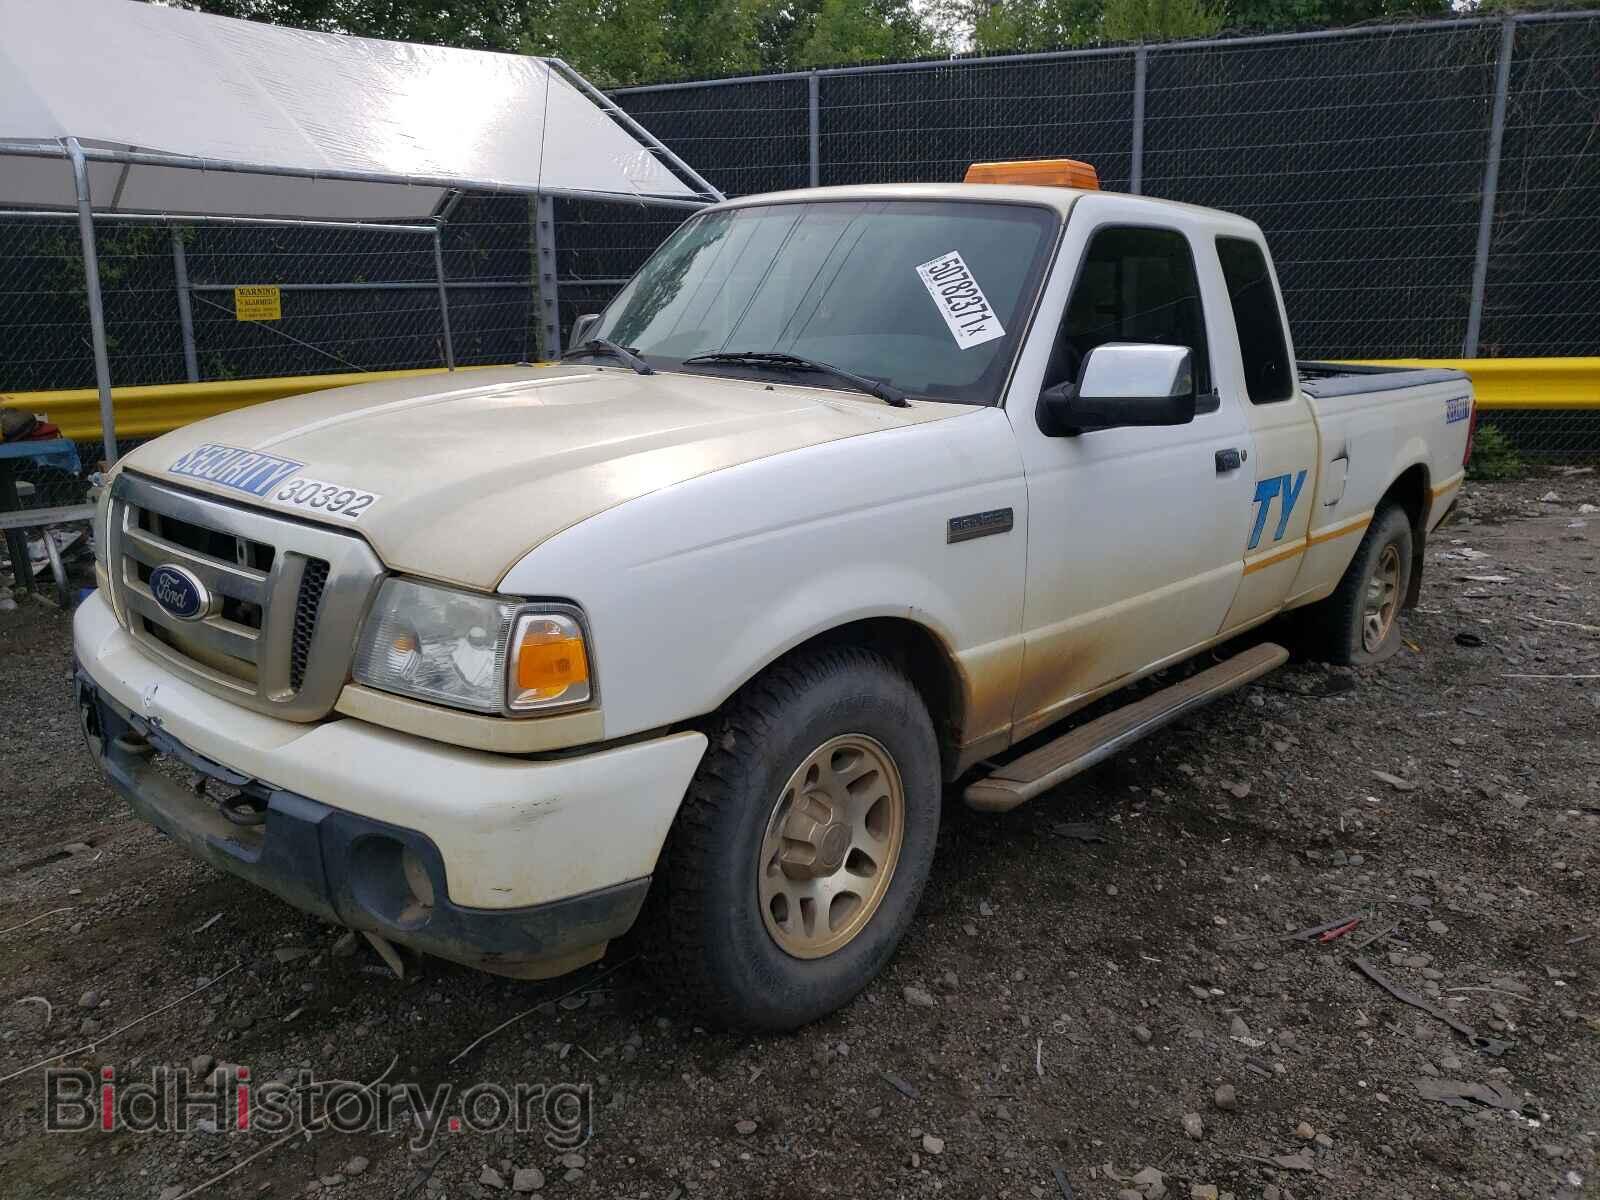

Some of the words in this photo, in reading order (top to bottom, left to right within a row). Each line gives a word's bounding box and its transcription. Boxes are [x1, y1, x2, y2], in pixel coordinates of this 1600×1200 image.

[239, 288, 277, 296] WARNING
[929, 258, 992, 328] 50782371
[174, 444, 300, 492] SECURITY
[278, 479, 375, 518] 30392
[1247, 469, 1308, 550] TY
[156, 573, 188, 610] Ford
